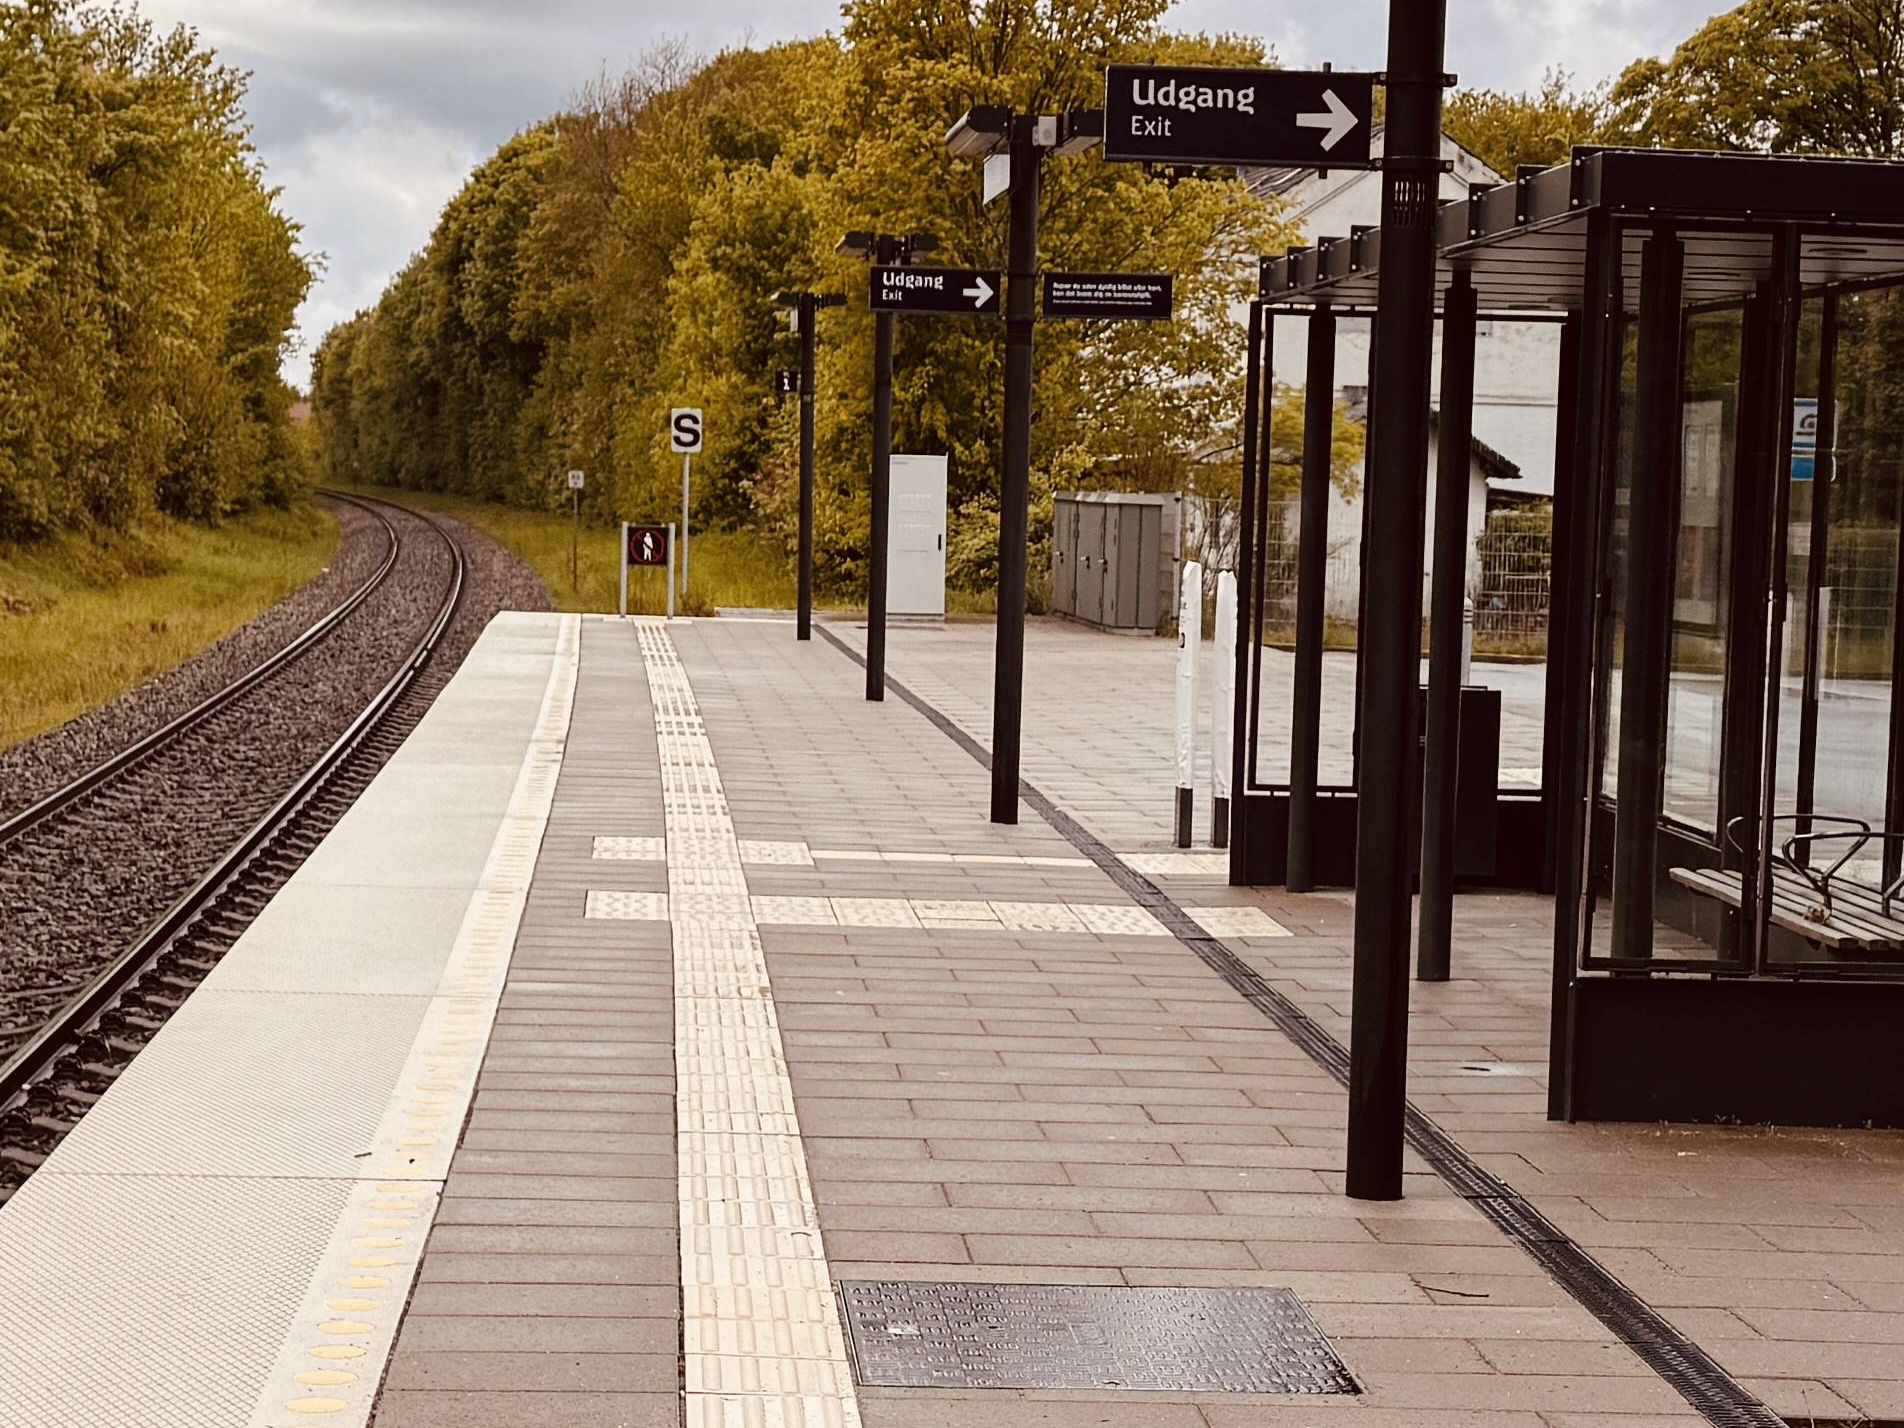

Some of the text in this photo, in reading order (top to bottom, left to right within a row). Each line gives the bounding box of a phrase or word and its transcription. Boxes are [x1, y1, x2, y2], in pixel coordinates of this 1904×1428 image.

[1132, 79, 1255, 114] Udgang
[1131, 115, 1172, 136] Exit
[882, 271, 944, 290] Udgang
[882, 289, 903, 301] Exit
[673, 413, 701, 447] S
